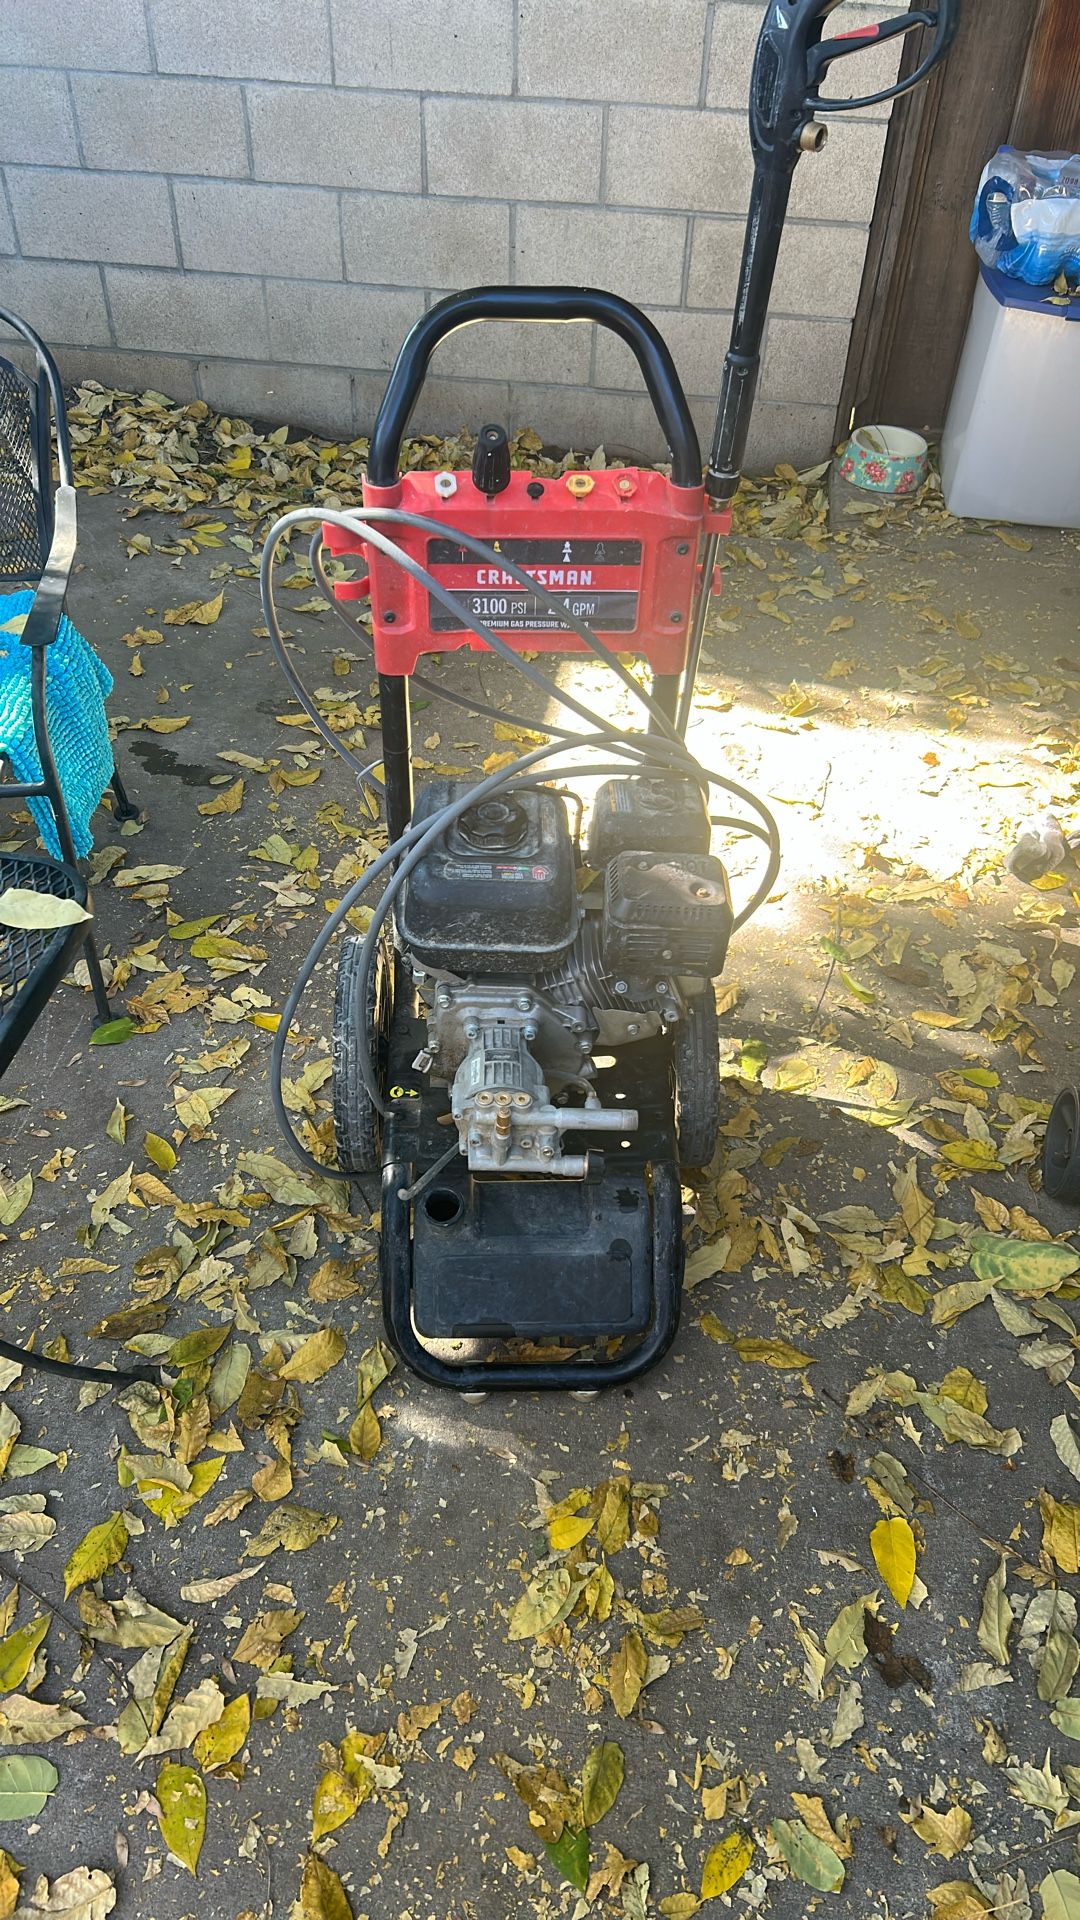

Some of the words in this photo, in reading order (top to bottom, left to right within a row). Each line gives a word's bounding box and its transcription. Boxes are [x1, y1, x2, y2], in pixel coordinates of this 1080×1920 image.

[477, 569, 592, 585] CRATSMAN
[472, 597, 507, 614] 3100
[511, 602, 527, 615] PSI
[572, 602, 595, 616] GPM
[510, 620, 524, 628] GAS
[525, 620, 559, 628] PRESSURE
